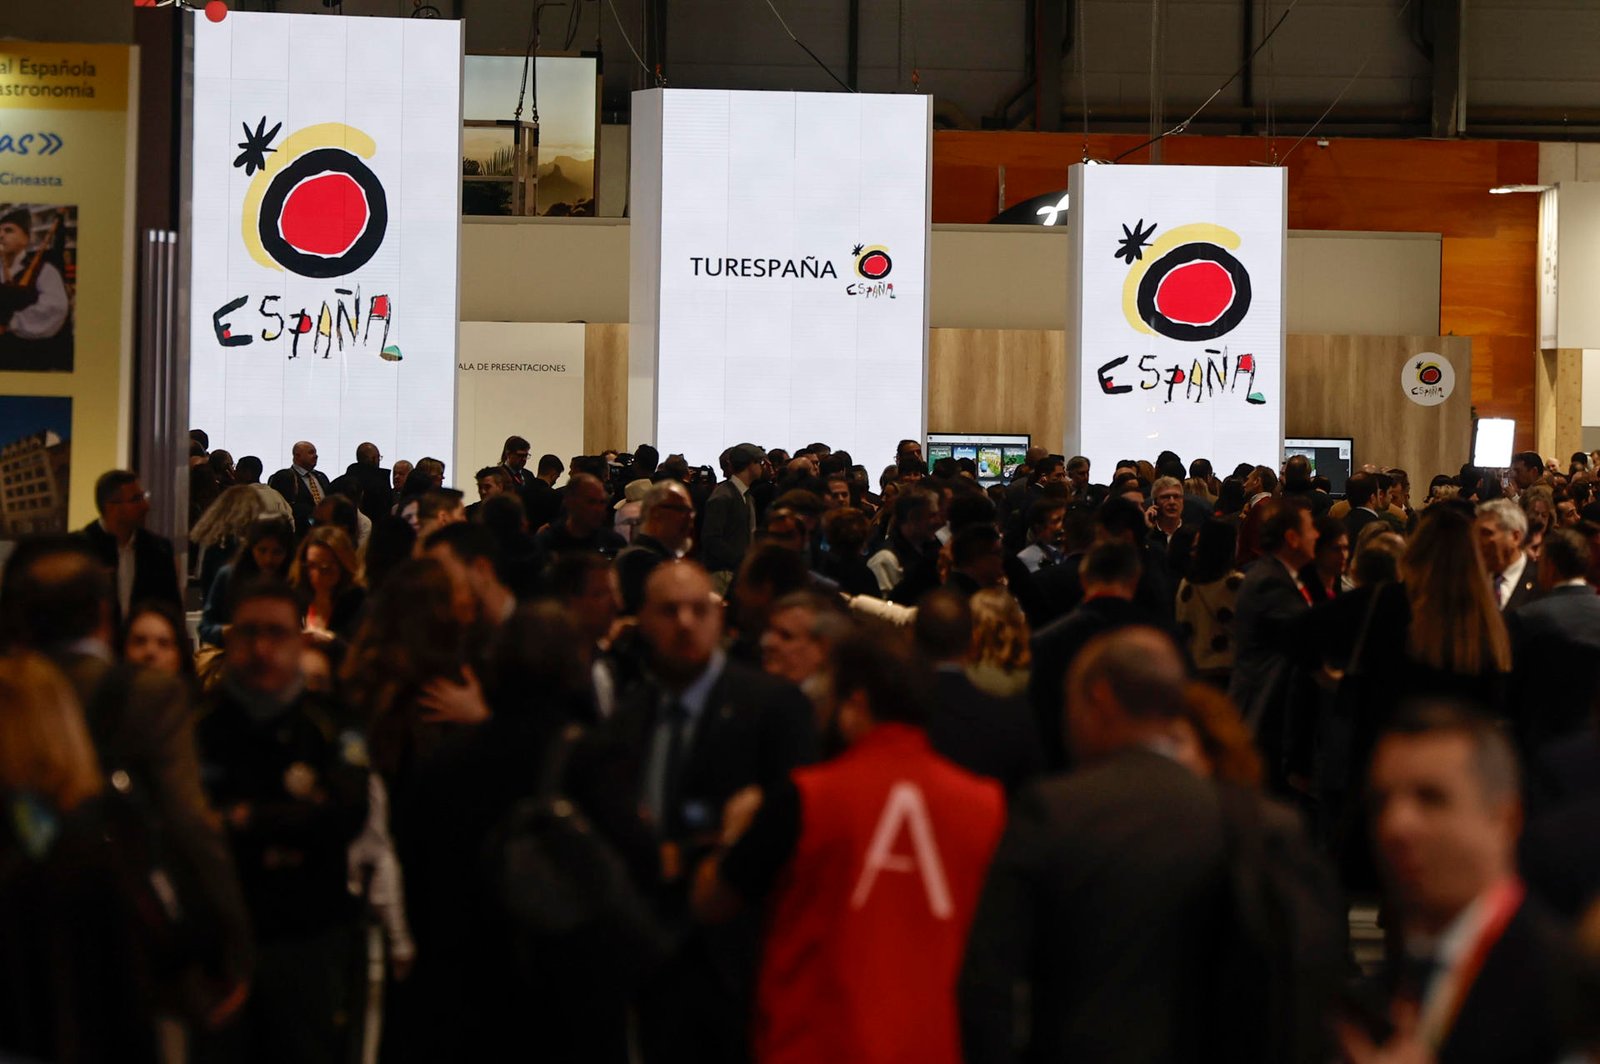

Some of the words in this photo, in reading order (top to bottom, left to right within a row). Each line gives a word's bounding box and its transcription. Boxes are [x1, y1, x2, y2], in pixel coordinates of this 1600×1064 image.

[20, 58, 96, 79] Española
[0, 172, 63, 187] Cineasta
[690, 256, 838, 279] TURESPAÑA
[846, 282, 897, 299] ESPAÑA
[212, 283, 403, 362] ESPAÑA
[477, 363, 489, 371] DE
[491, 363, 566, 373] PRESENTACIONES
[1097, 345, 1267, 405] ESPAÑA
[851, 780, 953, 920] A
